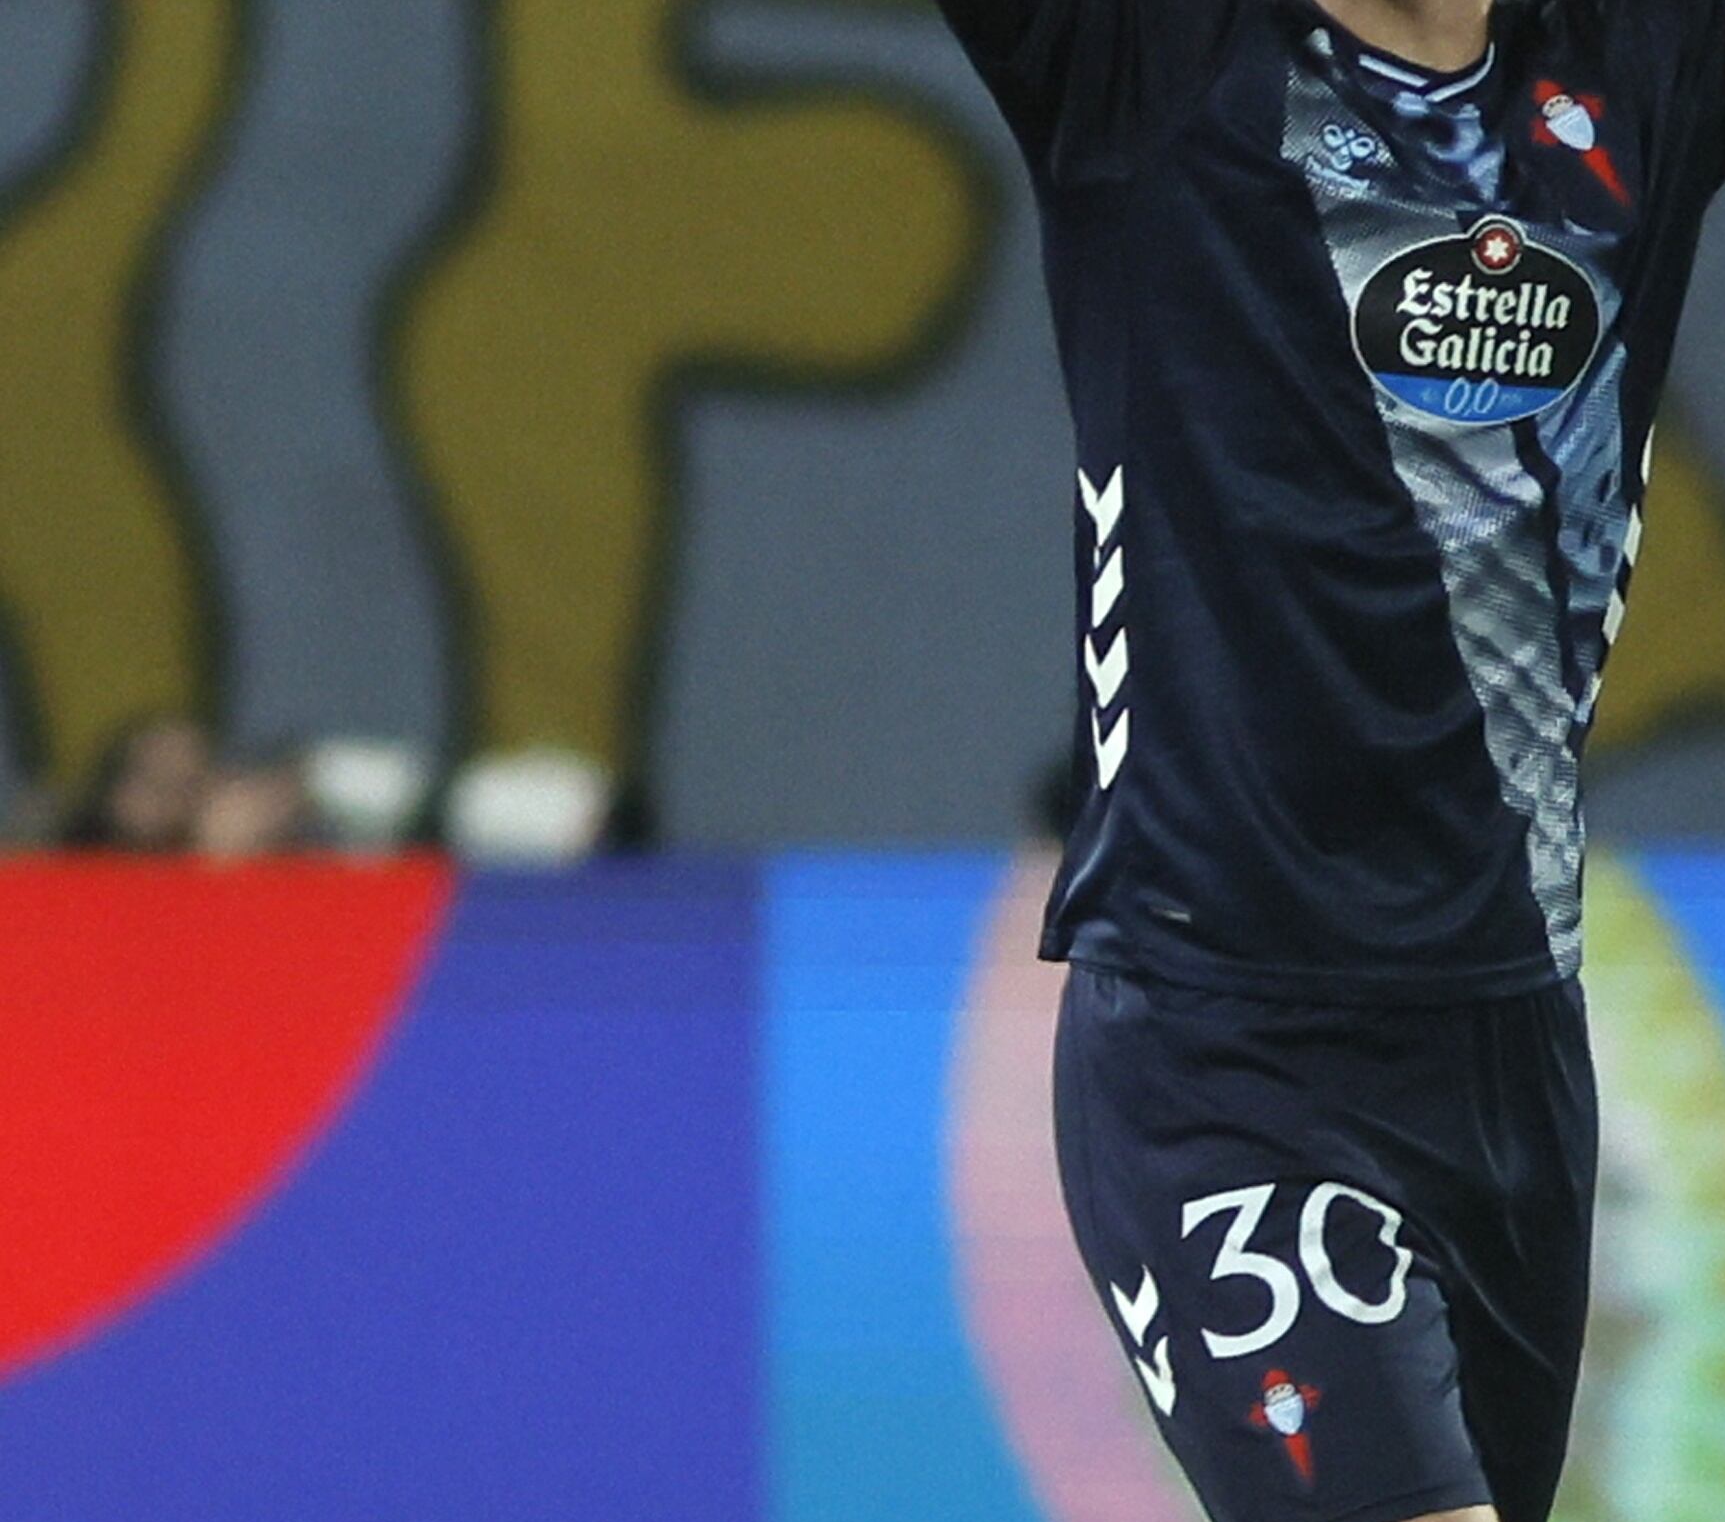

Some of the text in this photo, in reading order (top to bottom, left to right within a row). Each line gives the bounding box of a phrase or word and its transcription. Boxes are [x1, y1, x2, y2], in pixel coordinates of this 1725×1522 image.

[1396, 267, 1571, 330] Estrella
[1400, 319, 1554, 378] Galicia
[1180, 1180, 1413, 1359] 30
